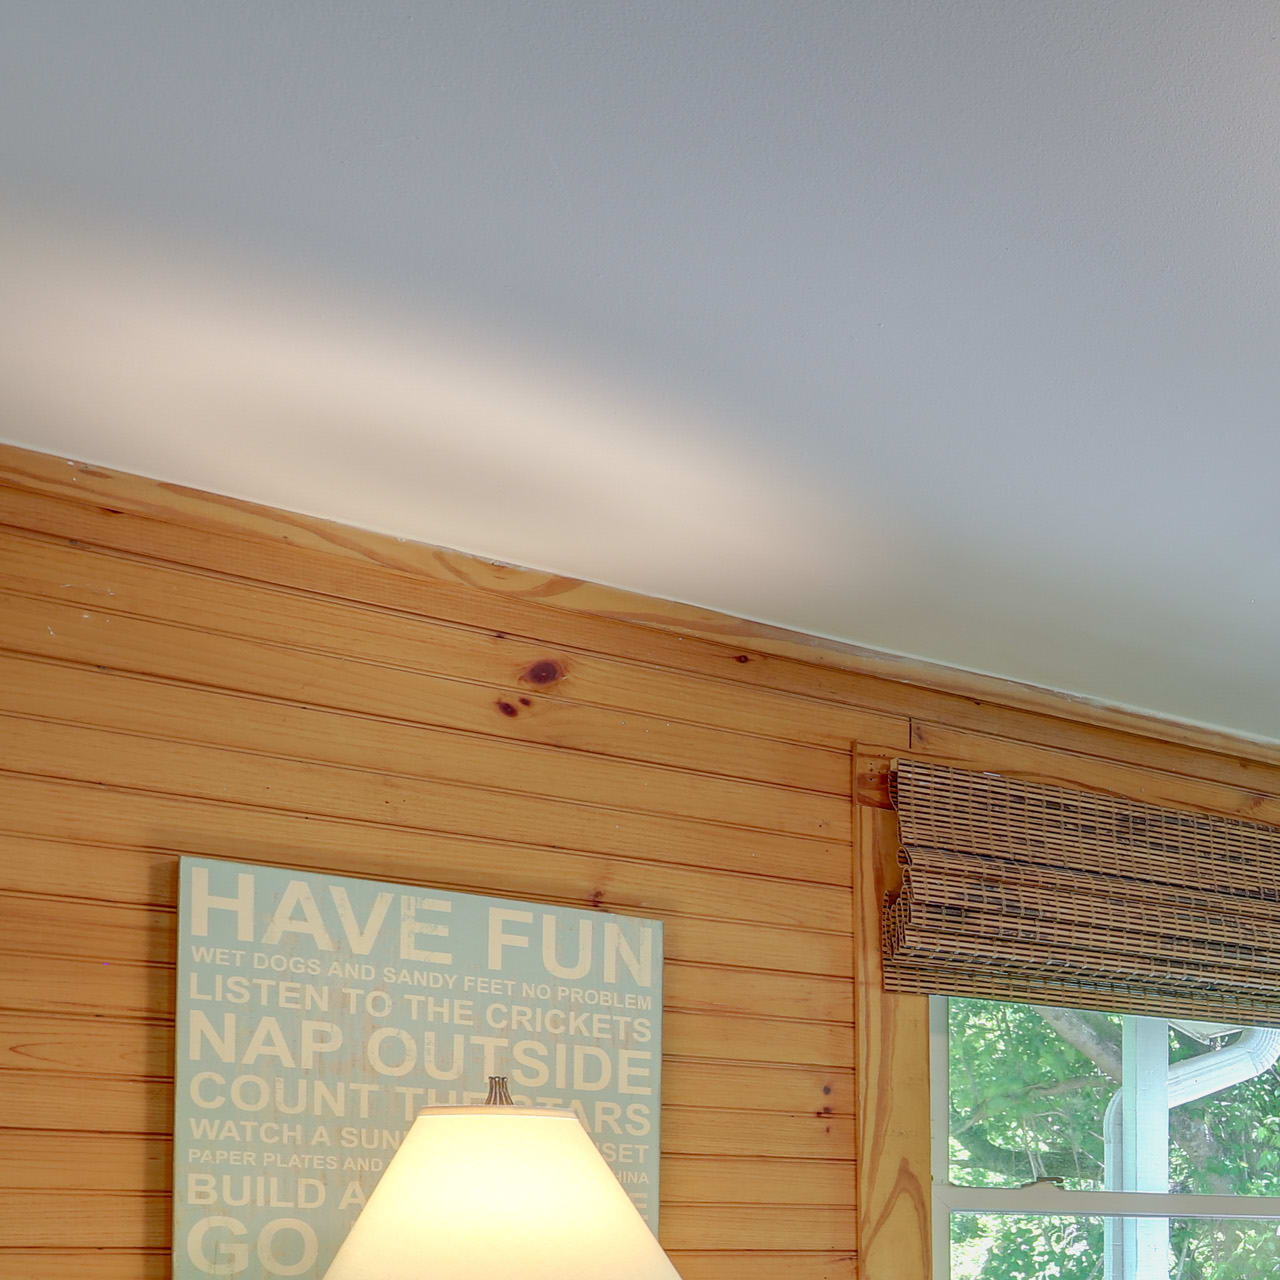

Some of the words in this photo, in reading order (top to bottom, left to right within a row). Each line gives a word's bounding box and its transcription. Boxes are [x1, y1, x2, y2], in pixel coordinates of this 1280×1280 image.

[191, 867, 452, 965] HAVE
[488, 907, 652, 987] FUN
[190, 972, 329, 1012] LISTEN
[342, 988, 392, 1018] TO
[404, 994, 473, 1026] THE
[485, 1003, 652, 1042] CRICKETS
[191, 946, 246, 967] WET
[253, 953, 321, 975] DOGS
[328, 961, 376, 980] AND
[383, 967, 458, 989] SANDY
[463, 976, 516, 995] FEET
[522, 983, 550, 999] NO
[557, 986, 652, 1010] PROBLEM
[188, 1009, 343, 1070] NAP
[367, 1027, 652, 1095] OUTSIDE
[190, 1071, 379, 1118] COUNT
[188, 1149, 256, 1166] PAPER
[263, 1152, 337, 1170] PLATES
[343, 1156, 383, 1172] AND
[190, 1118, 301, 1145] WATCH
[311, 1125, 331, 1146] A
[341, 1127, 407, 1150] SUN
[597, 1142, 649, 1163] SET
[187, 1173, 326, 1209] BUILD
[338, 1180, 368, 1209] A
[187, 1215, 318, 1276] GO
